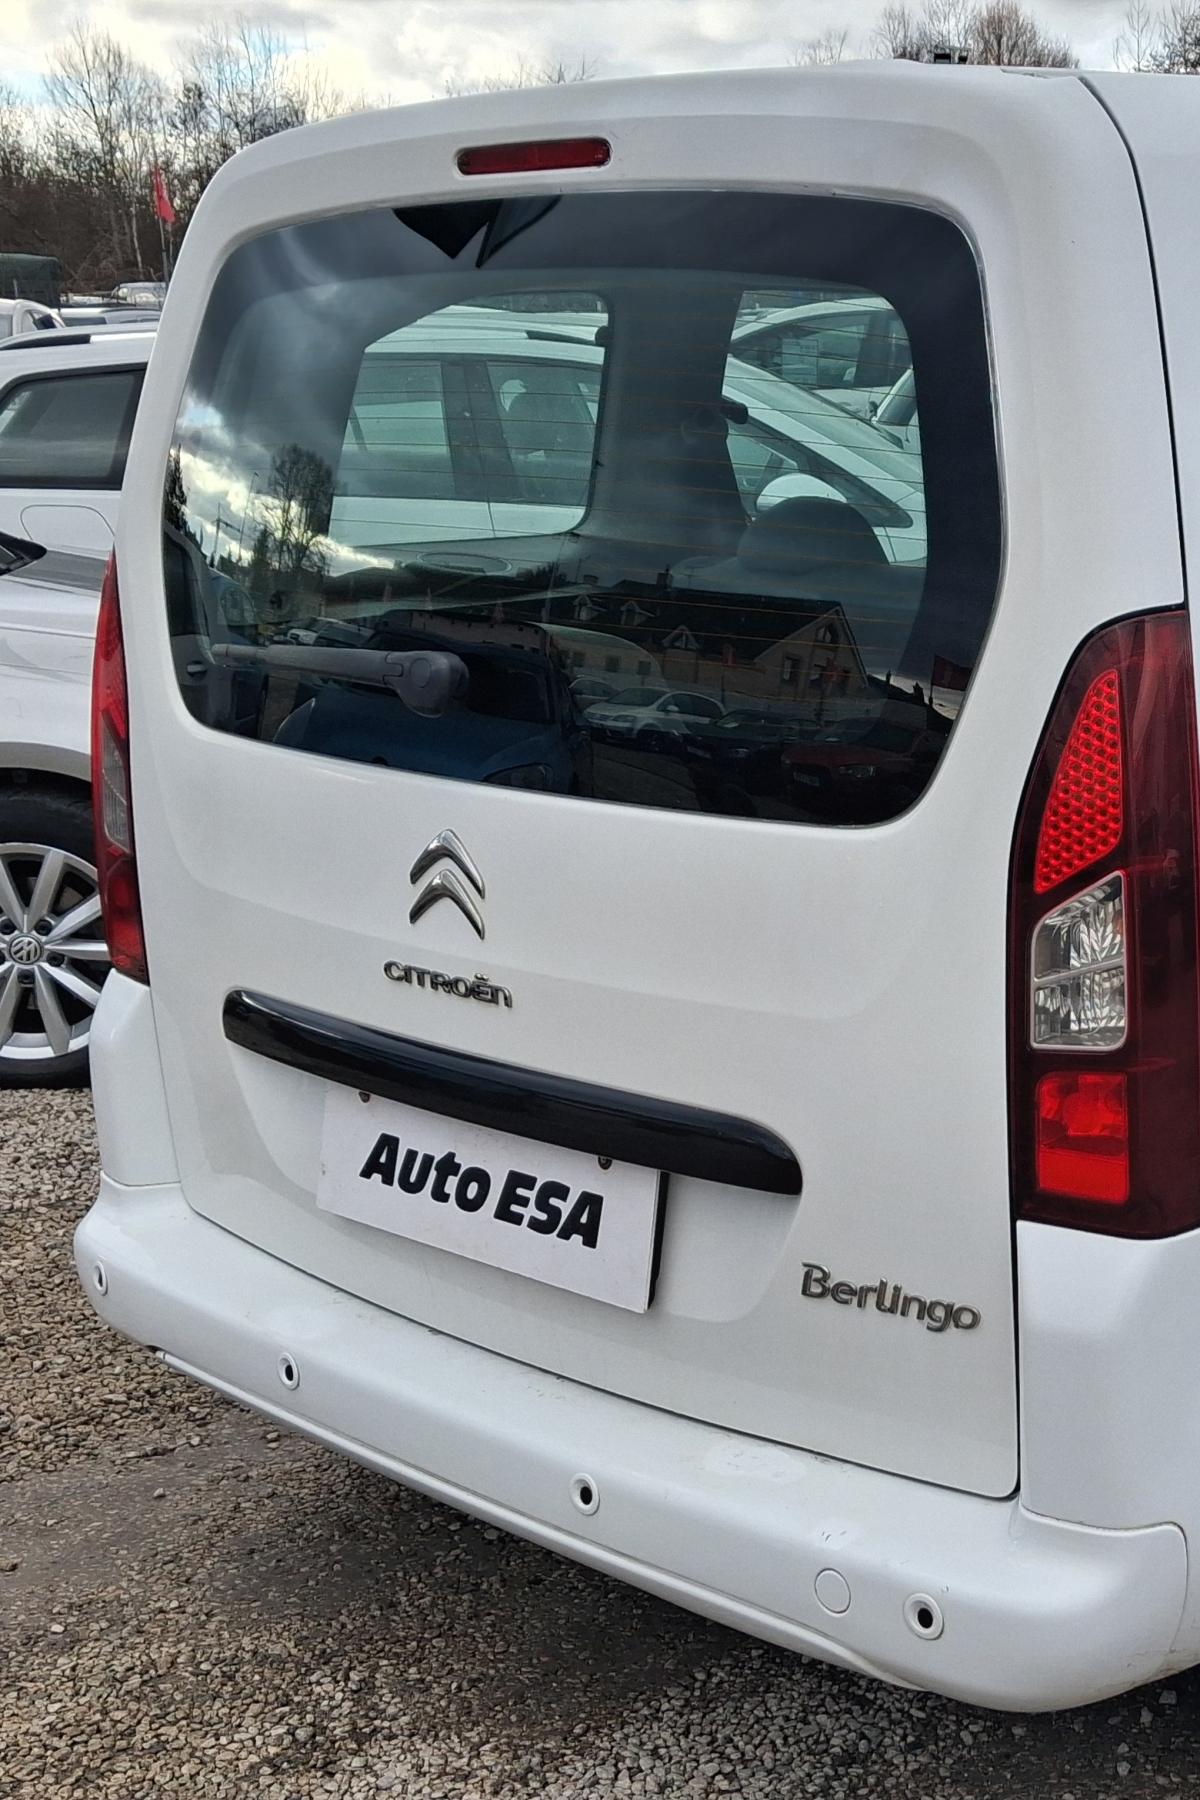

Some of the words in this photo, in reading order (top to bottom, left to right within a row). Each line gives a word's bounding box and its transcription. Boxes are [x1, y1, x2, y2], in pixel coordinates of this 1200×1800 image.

[359, 1132, 492, 1213] Auto
[493, 1169, 604, 1249] ESA
[801, 1261, 981, 1332] Berlingo
